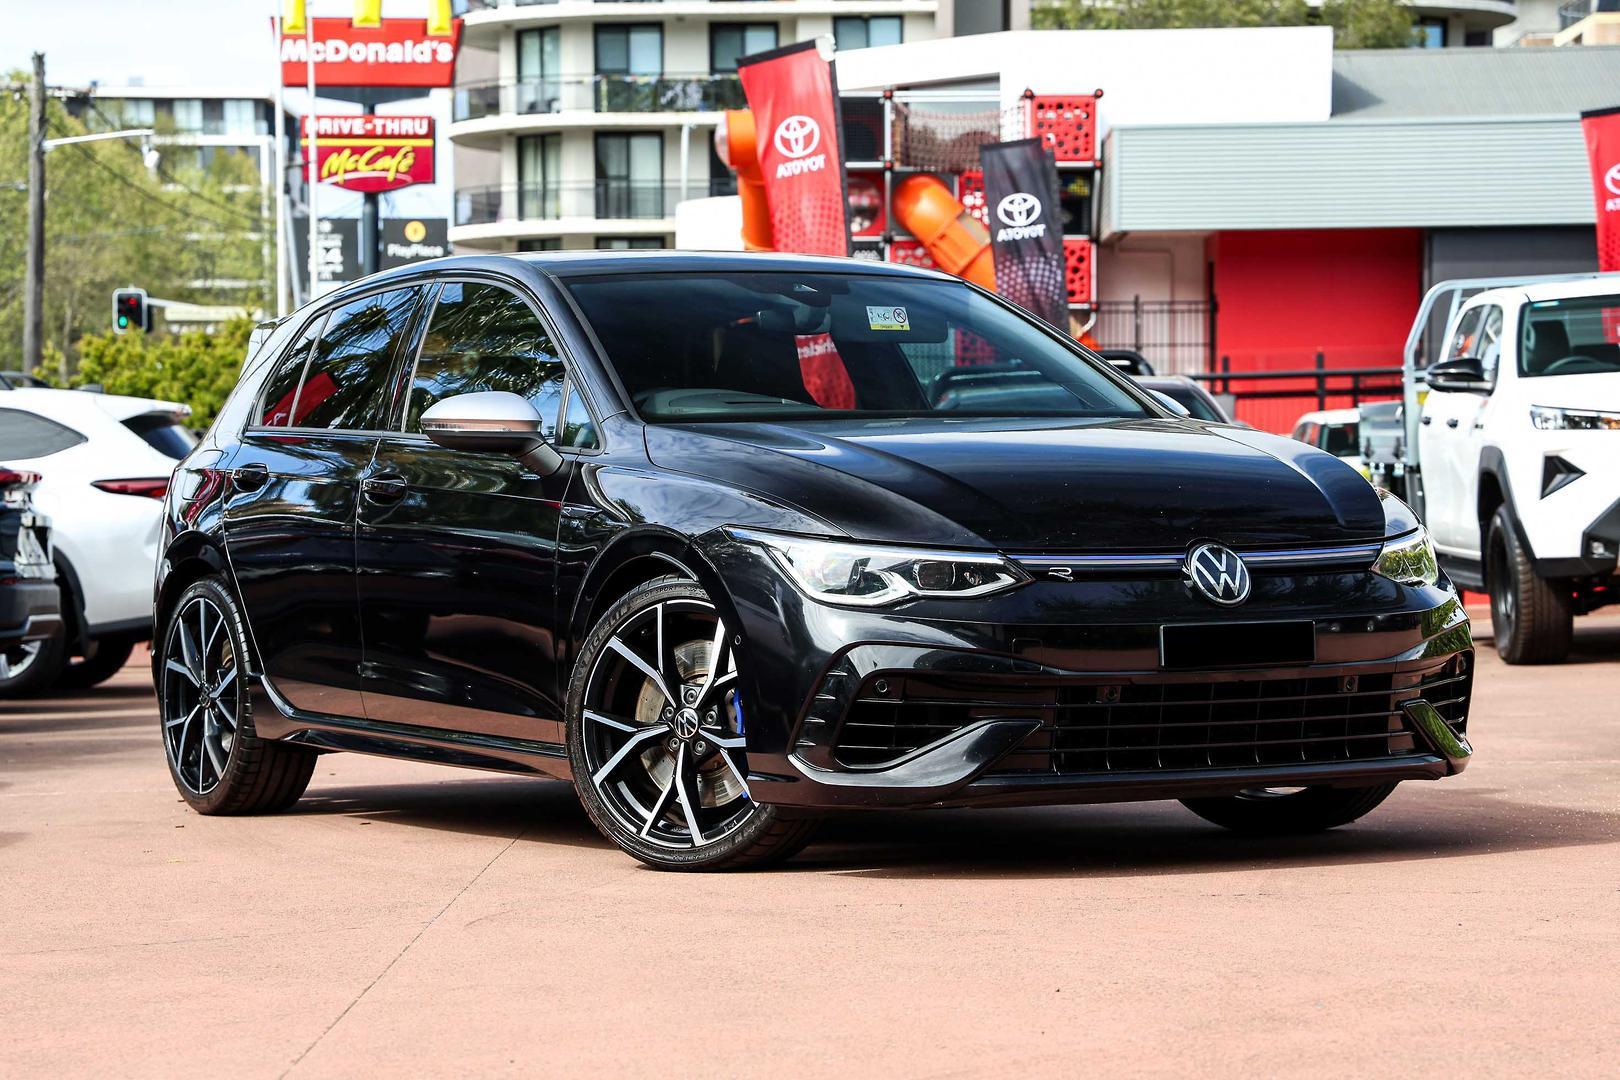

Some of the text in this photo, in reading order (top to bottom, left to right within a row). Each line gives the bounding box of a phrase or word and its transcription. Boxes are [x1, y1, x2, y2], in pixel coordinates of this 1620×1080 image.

[279, 38, 453, 63] McDonald's
[321, 145, 415, 184] McCafé
[387, 243, 444, 259] PlayPlace
